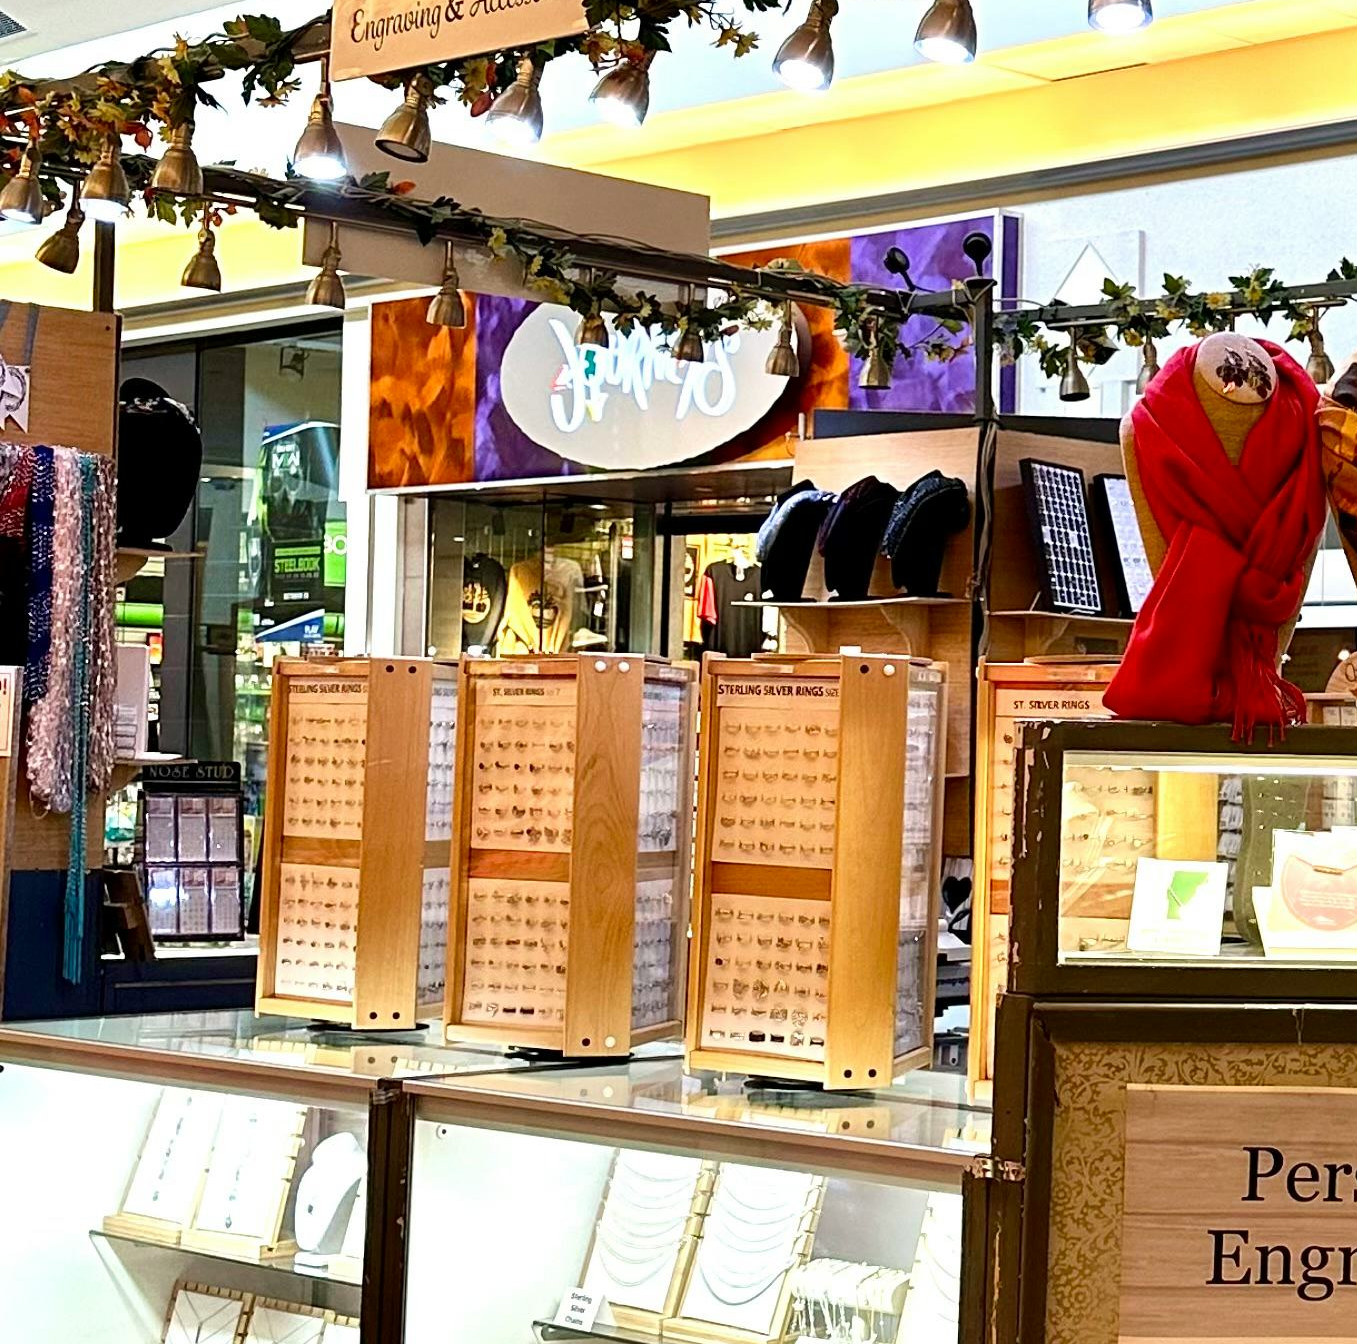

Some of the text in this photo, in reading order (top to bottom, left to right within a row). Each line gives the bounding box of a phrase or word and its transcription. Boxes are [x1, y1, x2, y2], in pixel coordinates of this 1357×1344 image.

[350, 0, 442, 52] Engraving
[718, 684, 761, 695] STERLING
[763, 685, 793, 696] SILVER
[795, 686, 823, 696] RINGS
[1029, 700, 1059, 710] SILVER
[1061, 700, 1090, 710] RINGS
[149, 764, 235, 778] NOSE STUD
